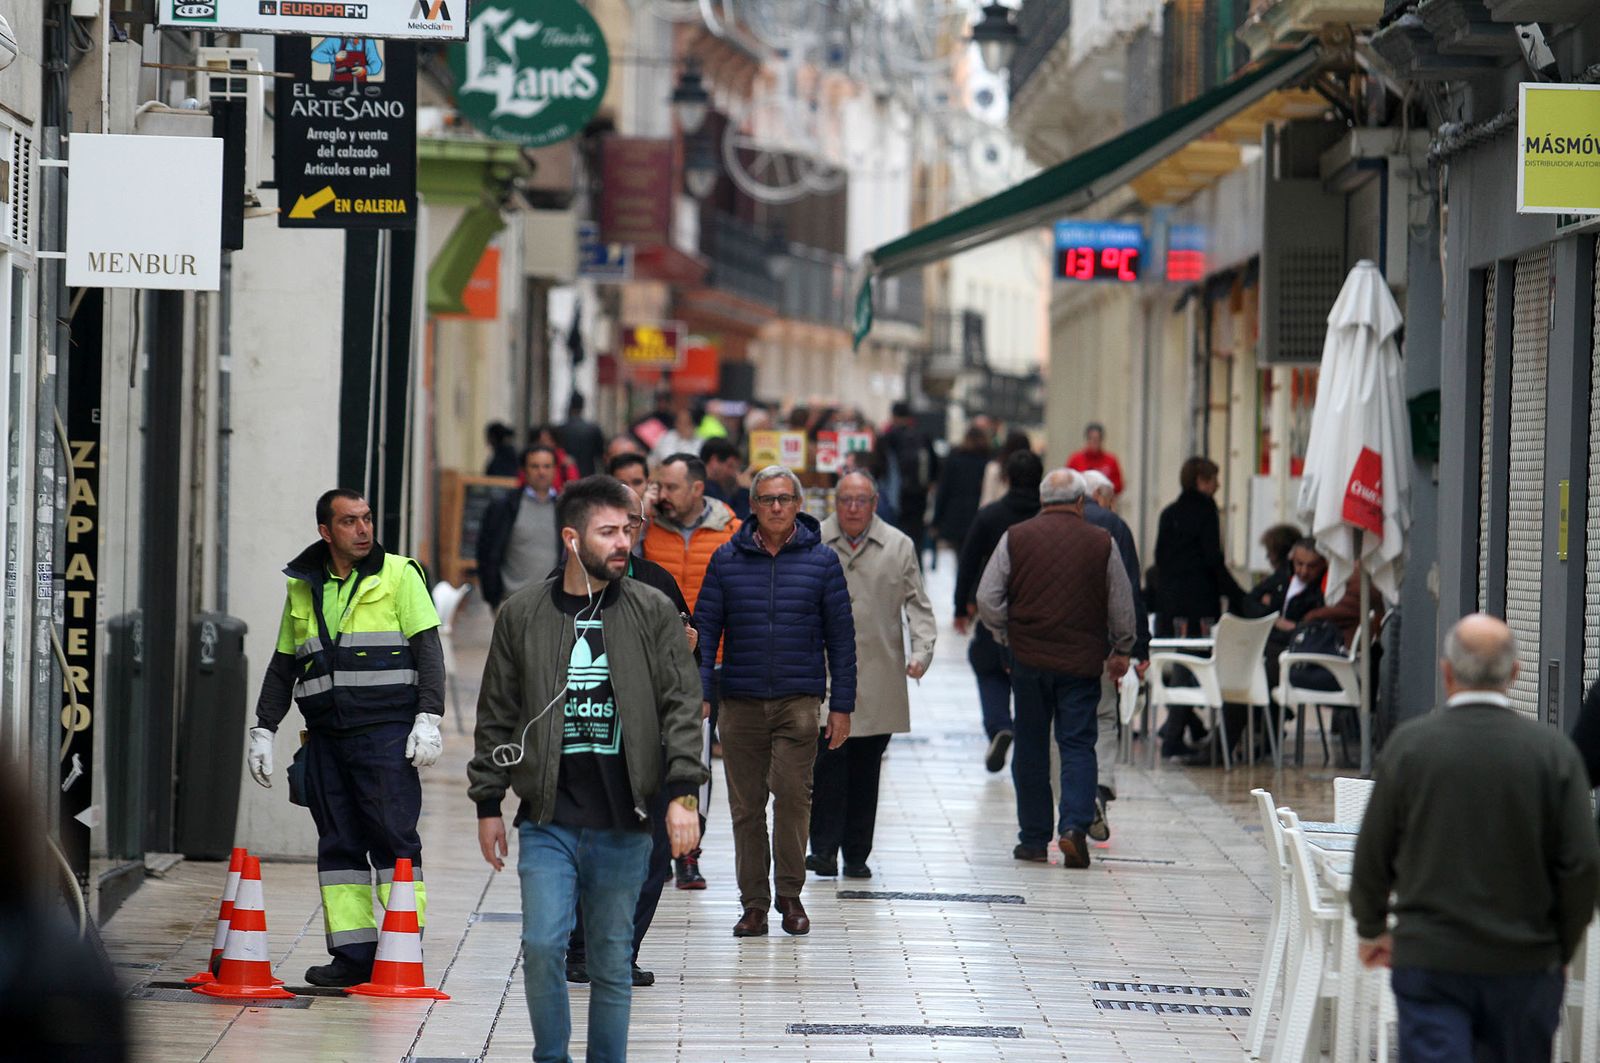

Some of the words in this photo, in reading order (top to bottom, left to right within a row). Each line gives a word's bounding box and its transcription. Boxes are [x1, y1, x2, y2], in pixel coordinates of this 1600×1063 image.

[181, 6, 209, 14] CERO
[292, 83, 315, 97] EL
[290, 97, 405, 121] ARTESANO
[306, 127, 347, 143] Arreglo
[349, 131, 359, 143] y
[359, 130, 389, 141] venta
[317, 145, 335, 158] del
[337, 145, 379, 159] calzado
[304, 162, 350, 176] Artículos
[353, 165, 367, 176] en
[369, 163, 391, 178] piel
[334, 199, 351, 213] EN
[354, 199, 407, 213] GALERIA
[88, 251, 198, 276] MENBUR
[1065, 247, 1095, 280] 13
[60, 440, 97, 732] ZAPATERO
[564, 697, 613, 717] didas
